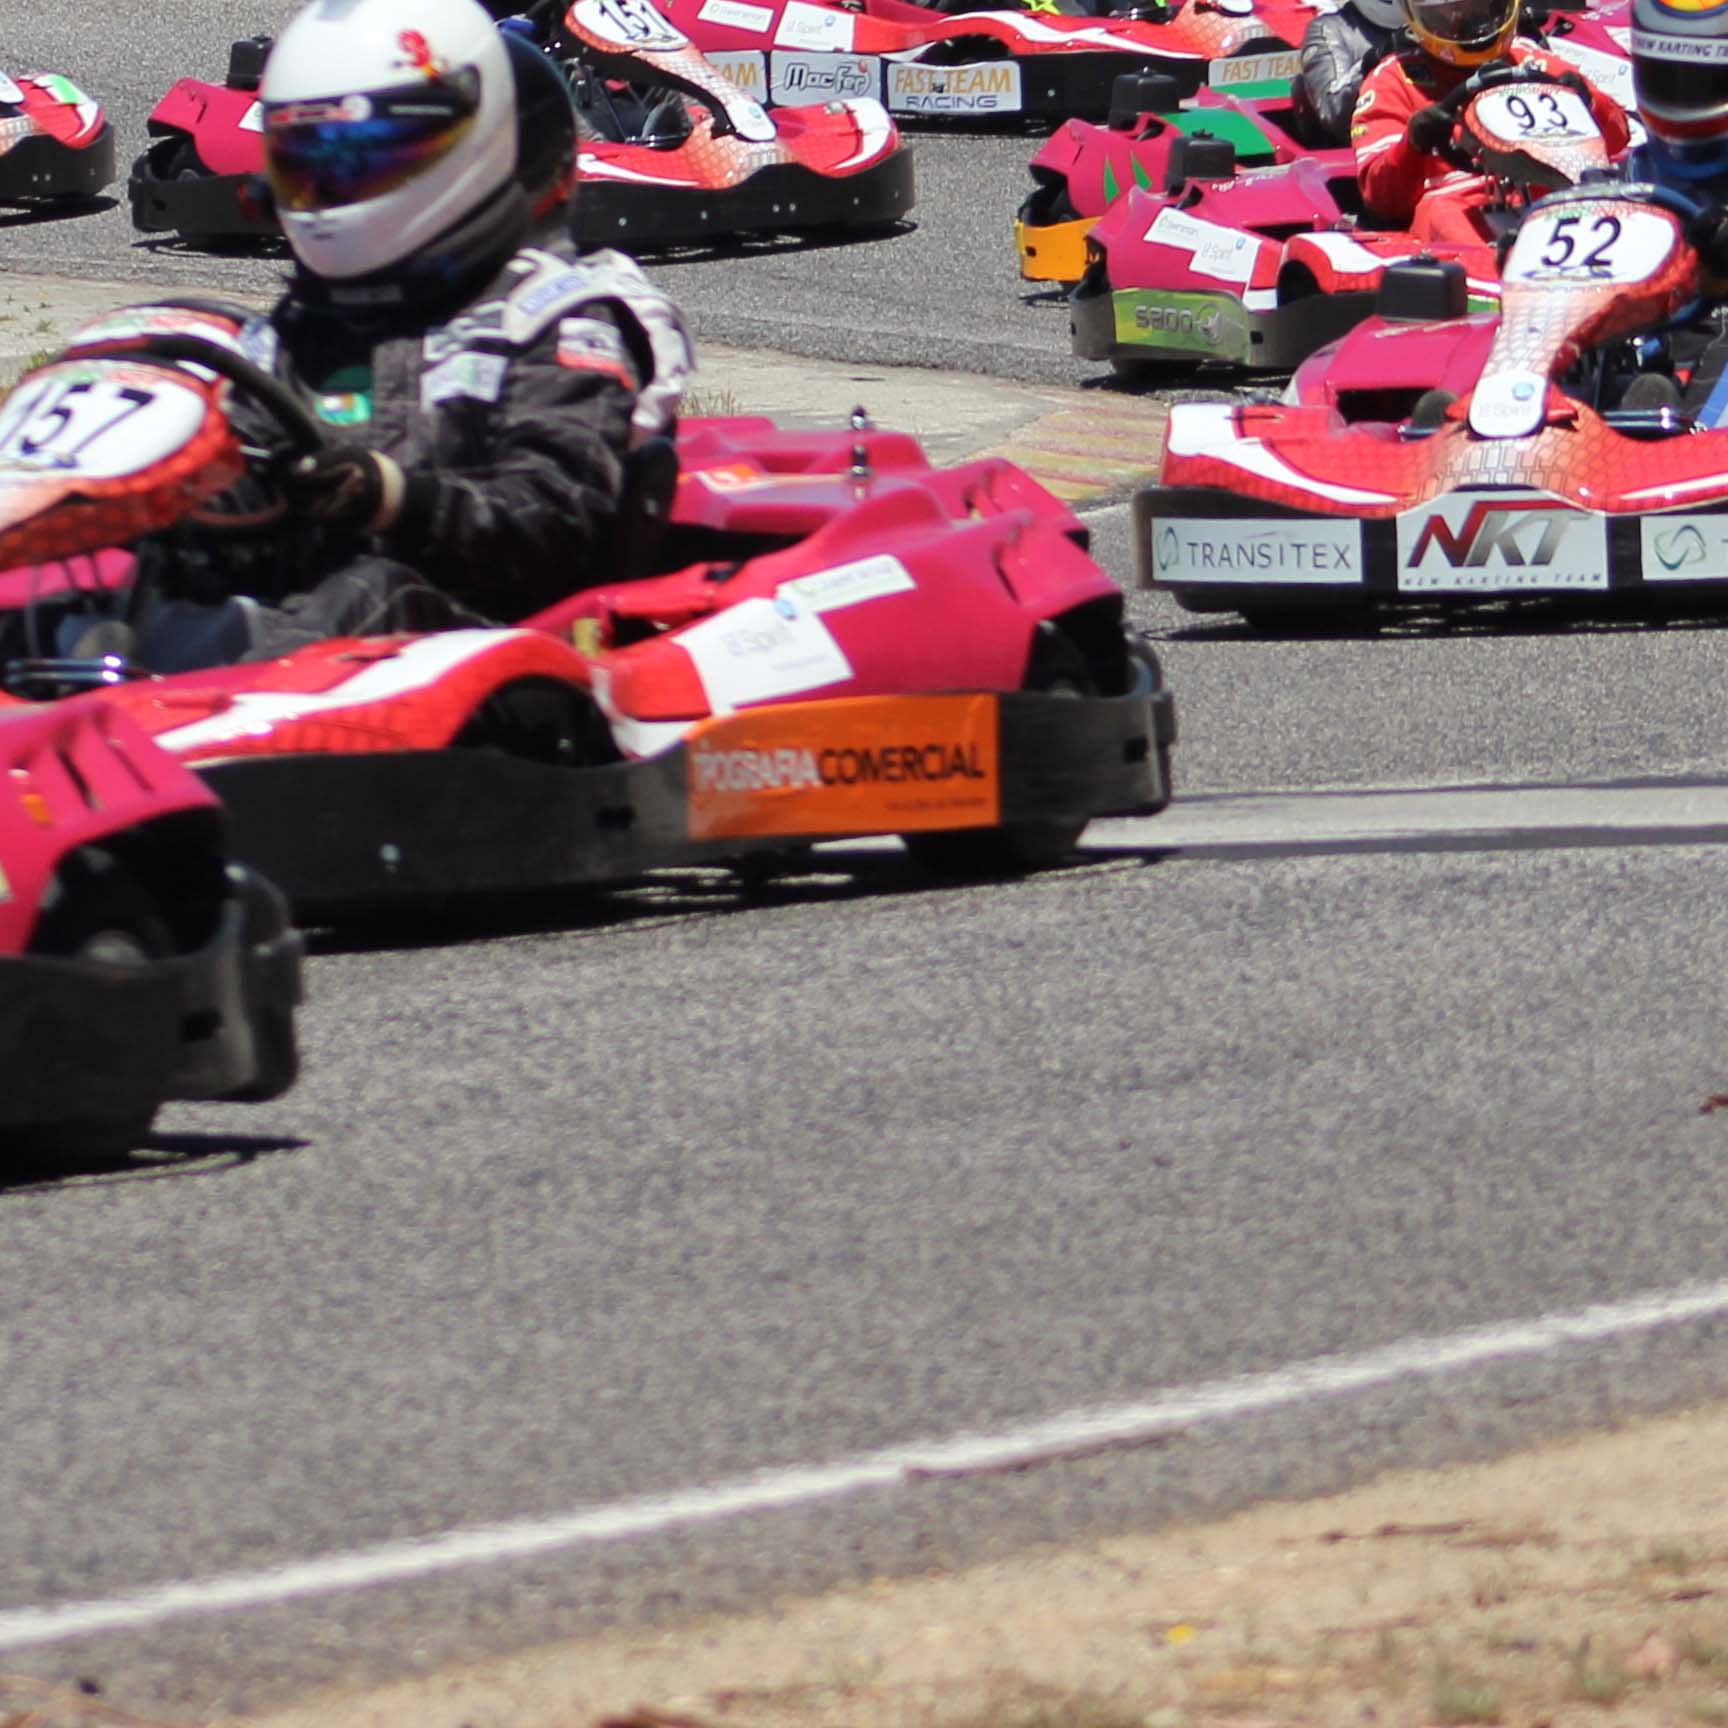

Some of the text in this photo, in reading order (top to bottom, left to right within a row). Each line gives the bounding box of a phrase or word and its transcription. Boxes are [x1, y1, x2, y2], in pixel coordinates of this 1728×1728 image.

[1658, 42, 1712, 57] KARTING
[895, 68, 1014, 95] FAST TEAM
[906, 95, 998, 109] RACING
[1505, 94, 1569, 129] 93
[1541, 216, 1623, 267] 52
[1405, 499, 1589, 568] NKT
[1186, 541, 1353, 570] TRANSITEX
[819, 742, 985, 786] COMERCIAL
